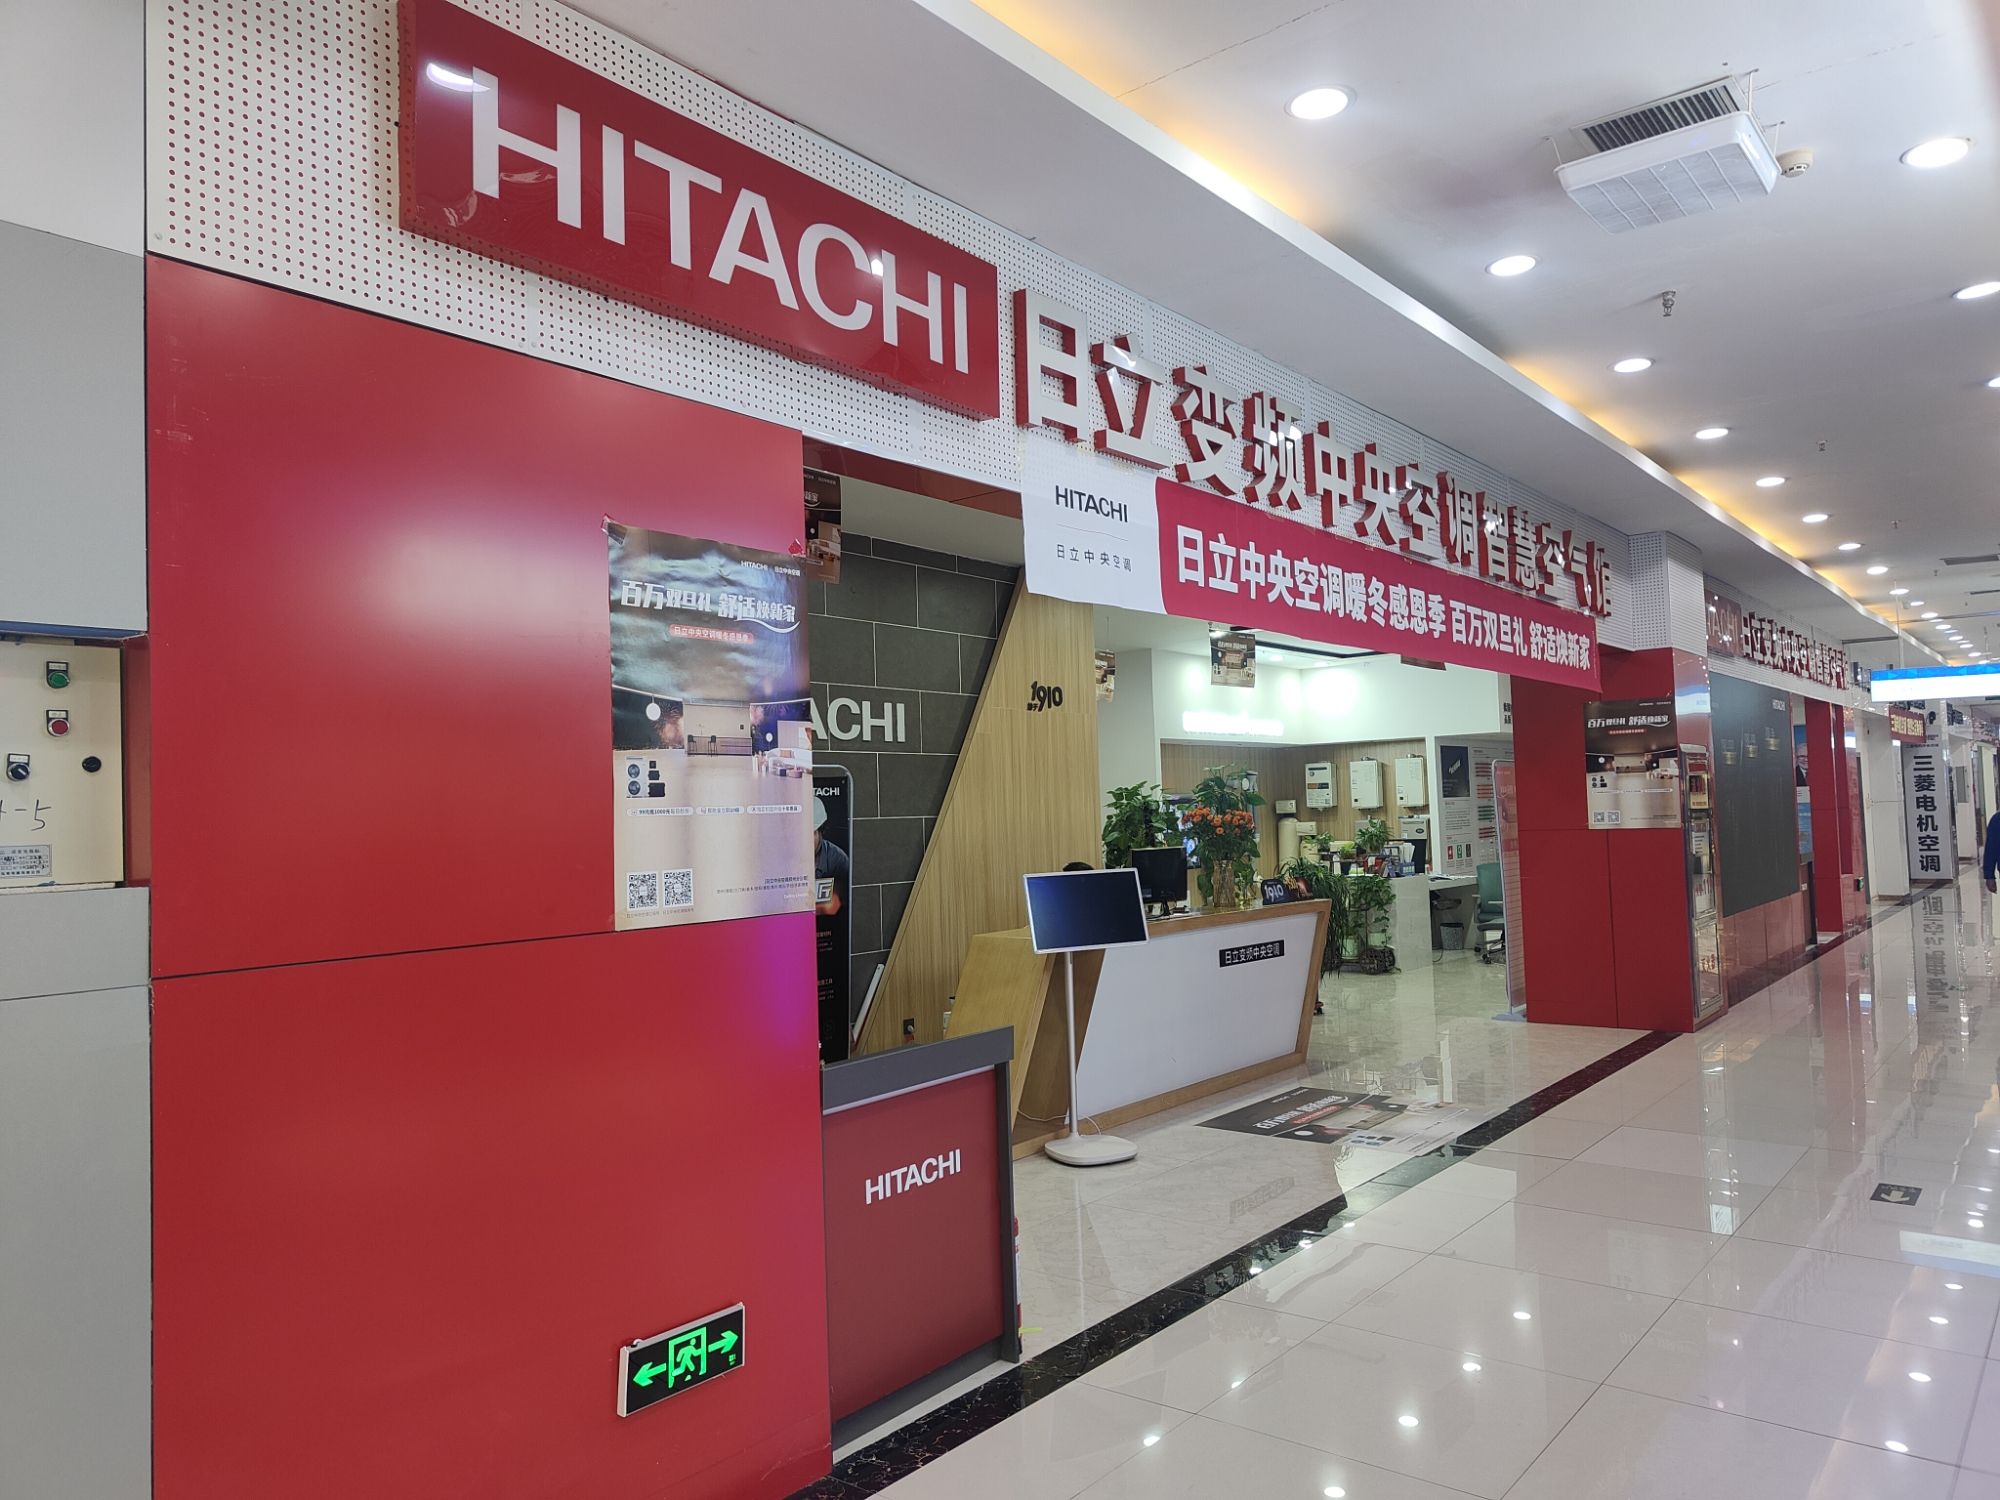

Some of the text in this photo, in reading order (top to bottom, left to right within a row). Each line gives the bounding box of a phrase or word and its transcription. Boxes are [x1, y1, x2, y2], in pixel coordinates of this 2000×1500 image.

[473, 66, 969, 374] HITACHI
[1013, 288, 1613, 618] 日立变频中央空调智慧空气馆
[1054, 484, 1129, 523] HITACHI
[740, 560, 769, 570] HITACHI
[1056, 544, 1132, 572] 日立中央空调
[620, 579, 796, 623] 百万双旦礼 舒适焕新家
[1177, 524, 1591, 671] 日立中央空调暖冬感恩季 百万双旦礼 舒适焕新家
[1030, 680, 1064, 712] 1910
[810, 697, 906, 743] ACHI
[812, 786, 840, 797] TACHI
[1912, 754, 1941, 873] 三菱电机空调
[1224, 942, 1280, 964] 日立变频中央空调
[864, 1148, 962, 1205] HITACHI
